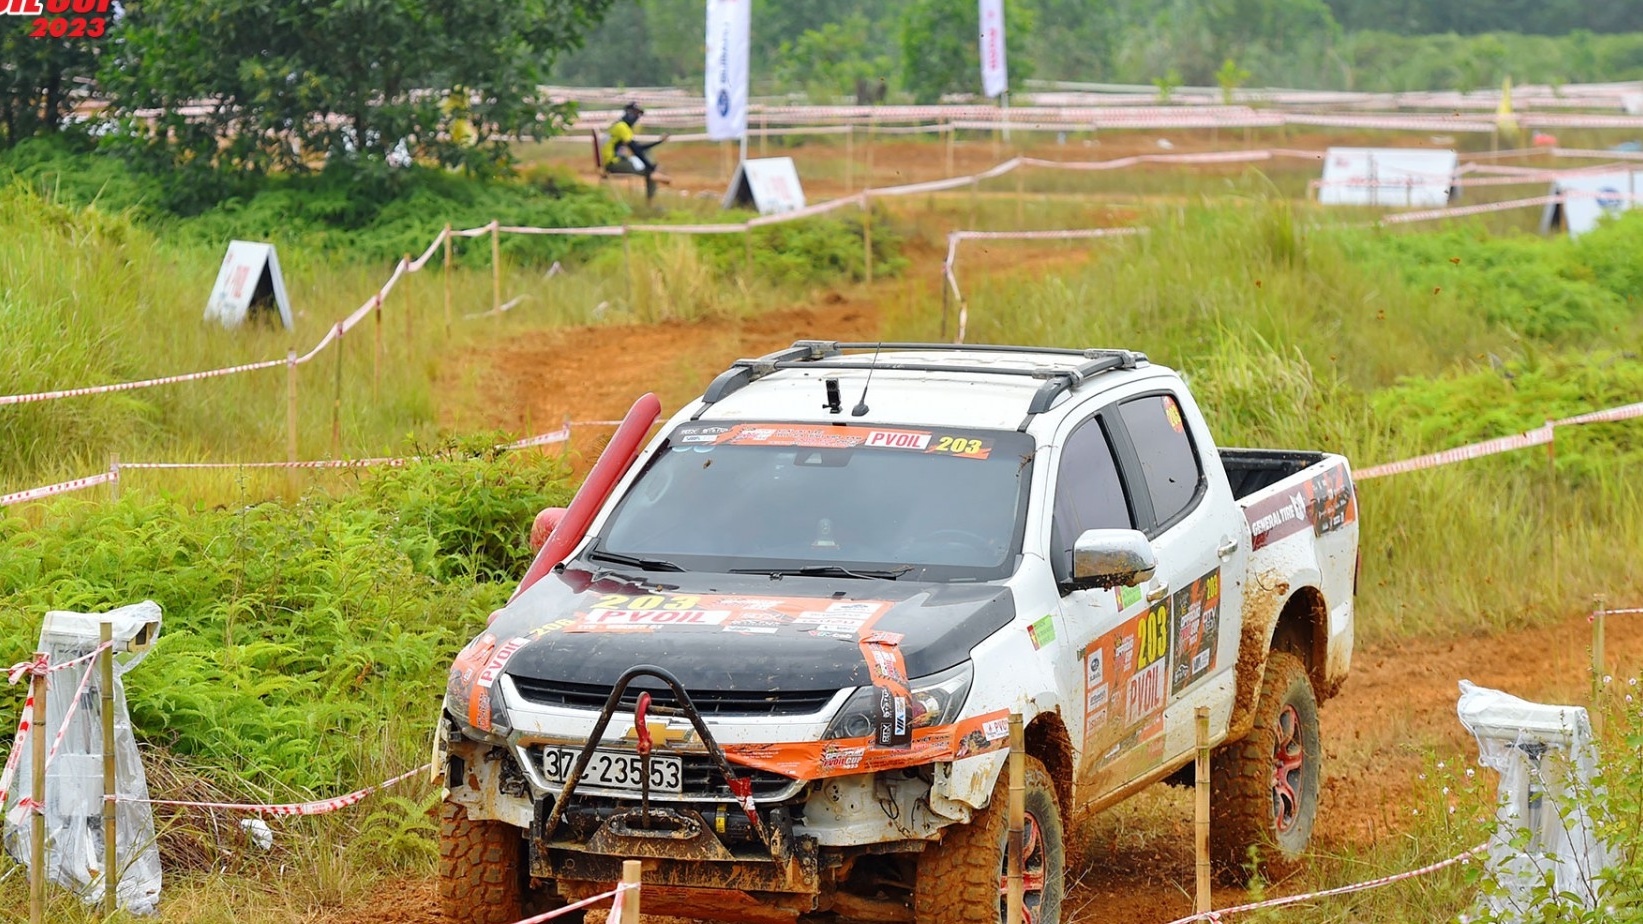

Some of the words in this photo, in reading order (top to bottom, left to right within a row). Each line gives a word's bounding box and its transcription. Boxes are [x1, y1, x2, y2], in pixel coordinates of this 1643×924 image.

[871, 432, 921, 448] PVOIL
[936, 436, 983, 454] 203
[1252, 510, 1282, 537] GENERAL
[1280, 504, 1295, 523] TIRE
[590, 594, 697, 610] 203
[597, 611, 706, 622] PVOIL
[1137, 605, 1167, 670] 203
[481, 641, 520, 682] PVOIL
[1129, 665, 1159, 722] PVOIL
